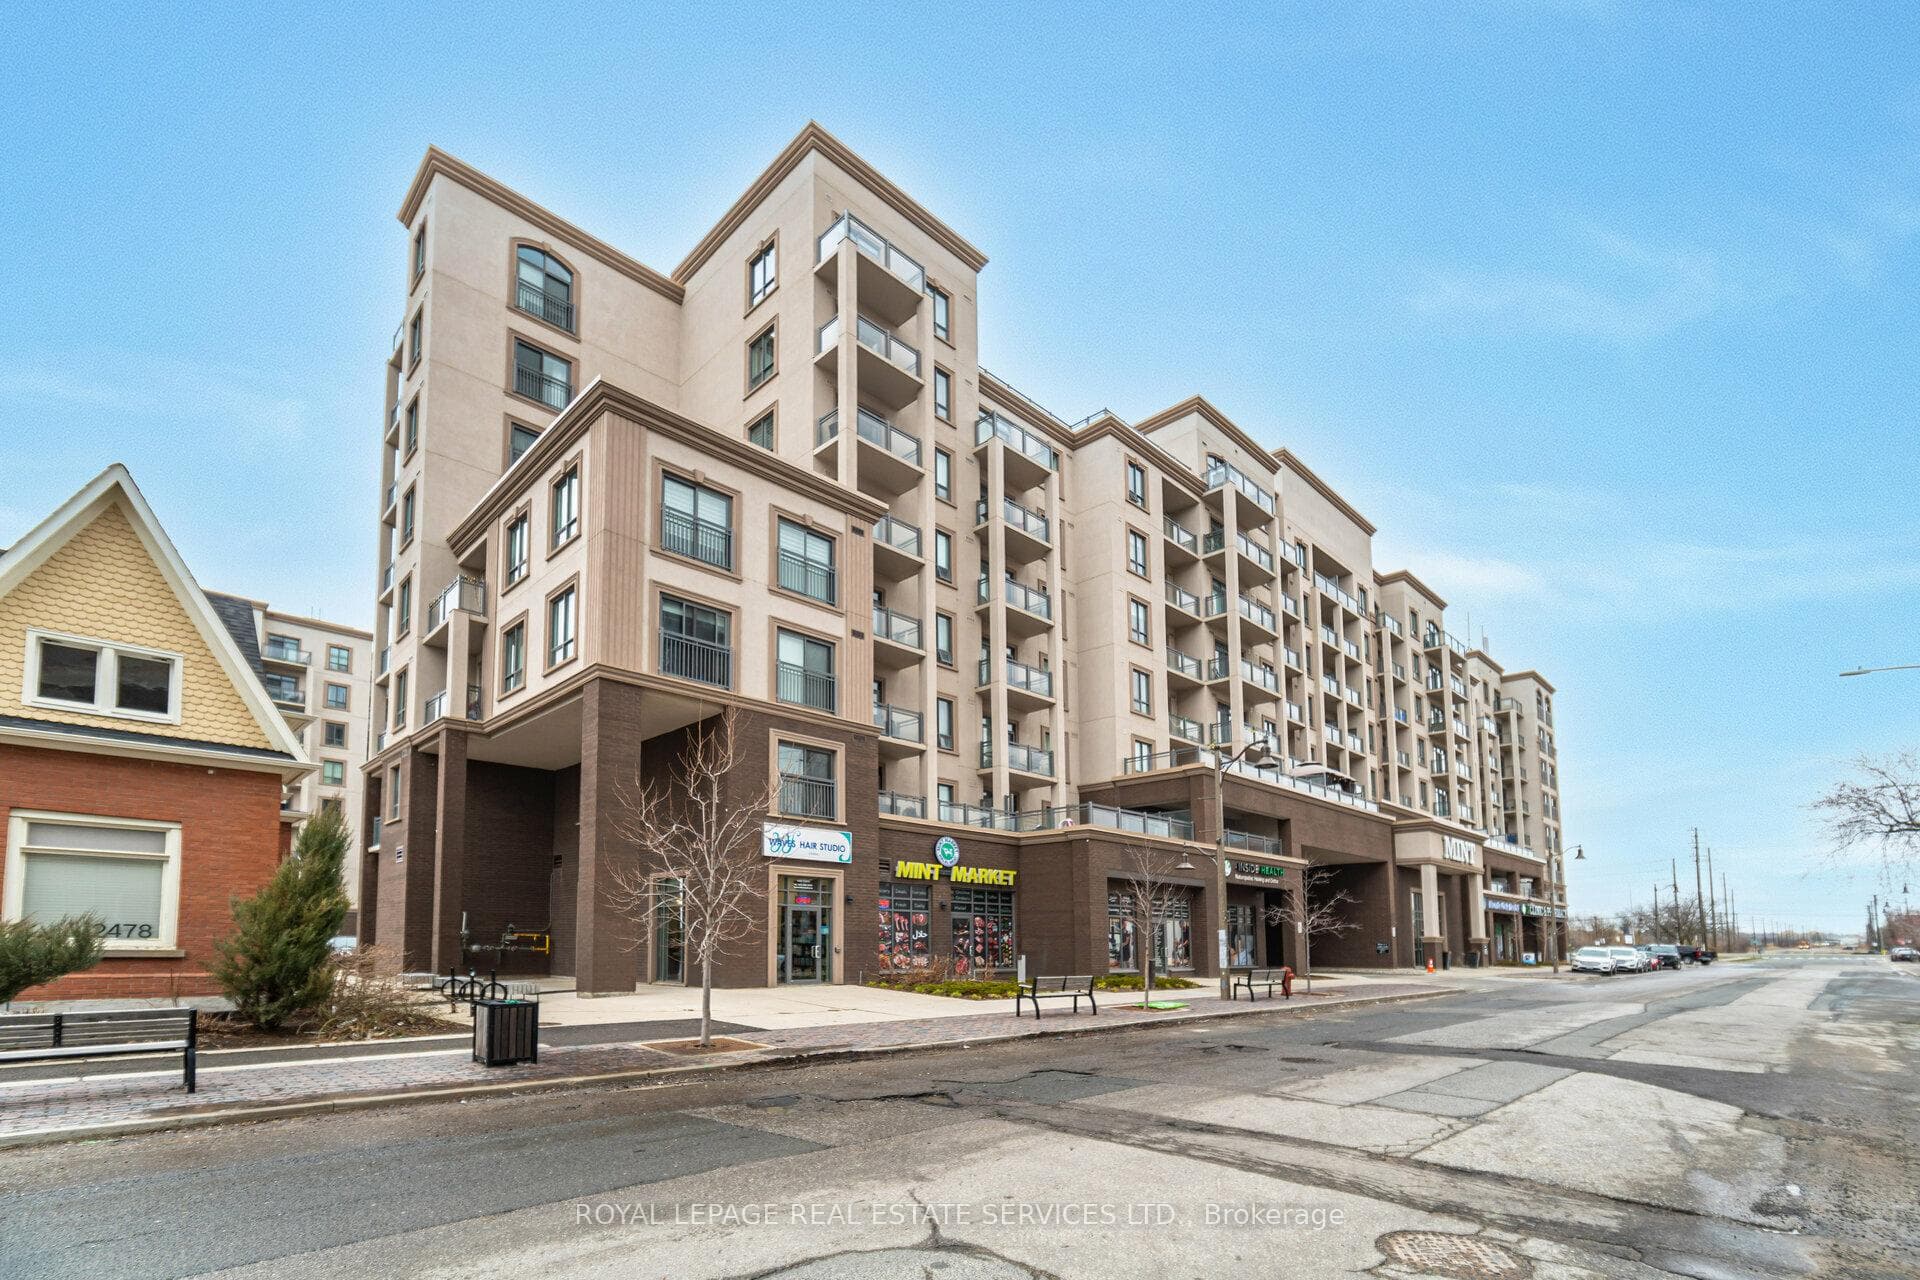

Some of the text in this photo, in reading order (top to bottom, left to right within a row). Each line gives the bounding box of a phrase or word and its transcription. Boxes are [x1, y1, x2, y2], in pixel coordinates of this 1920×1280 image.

[799, 841, 818, 850] HAIR
[819, 843, 846, 853] STUDIO
[1442, 835, 1476, 865] MINT
[895, 860, 943, 881] MINT
[950, 865, 1017, 886] MARKET
[1235, 862, 1285, 877] INSIDE HEALTH
[94, 923, 152, 939] 2478
